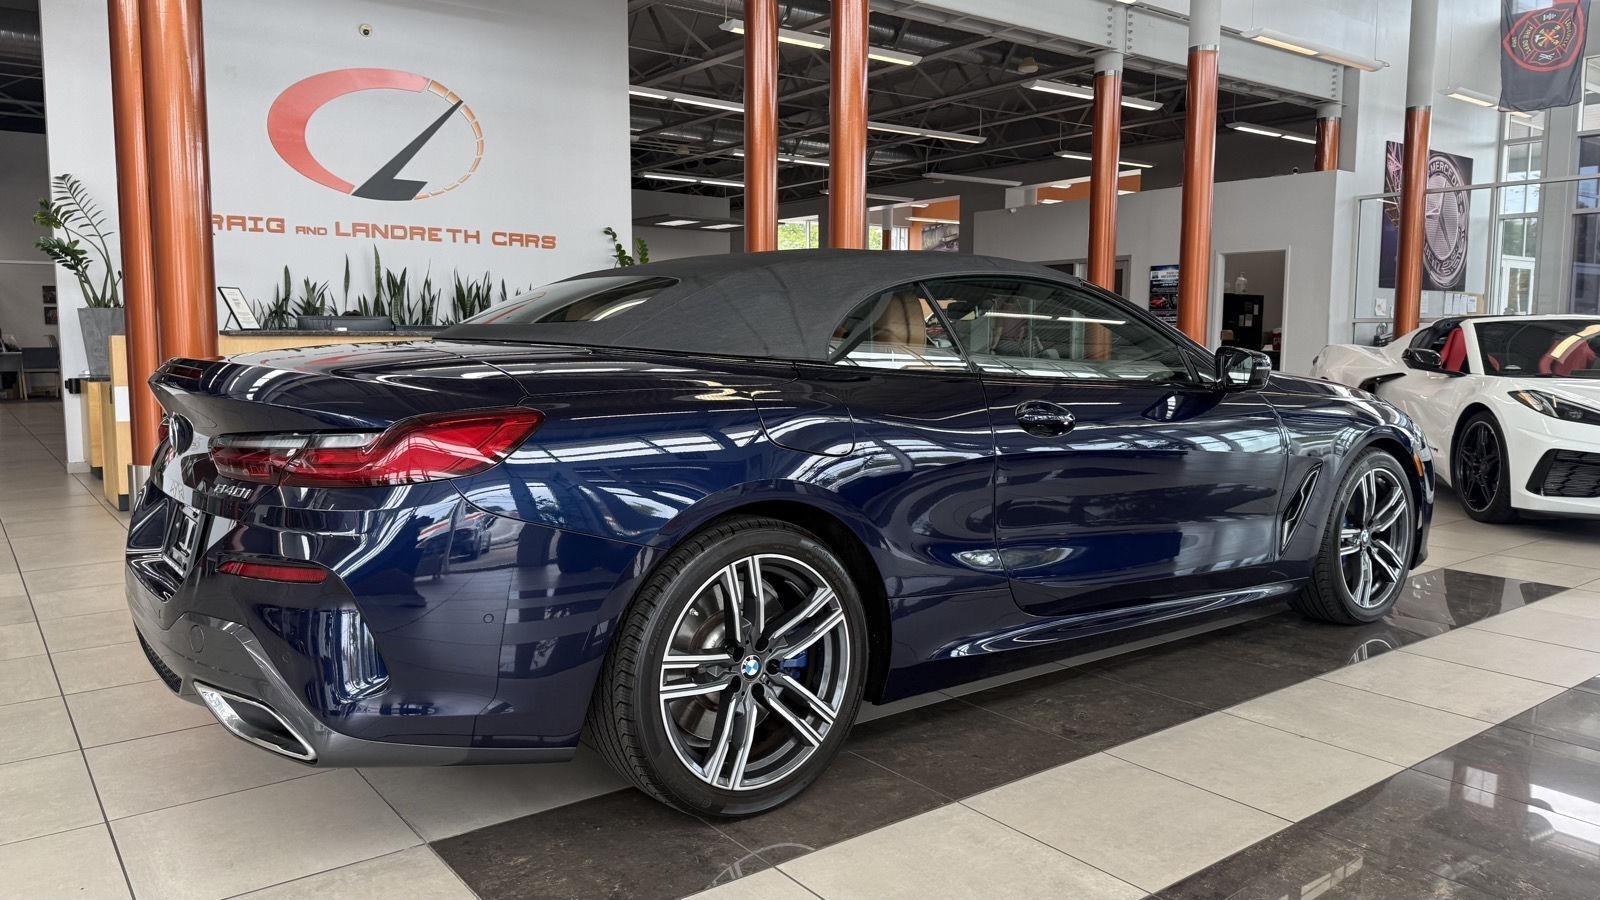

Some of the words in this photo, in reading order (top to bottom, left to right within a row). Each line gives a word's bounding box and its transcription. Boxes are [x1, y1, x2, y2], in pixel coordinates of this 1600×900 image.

[212, 214, 285, 233] RAIG
[295, 225, 328, 236] AND
[335, 221, 480, 244] LANDRETH
[491, 231, 556, 249] CARS
[213, 483, 252, 499] 840i
